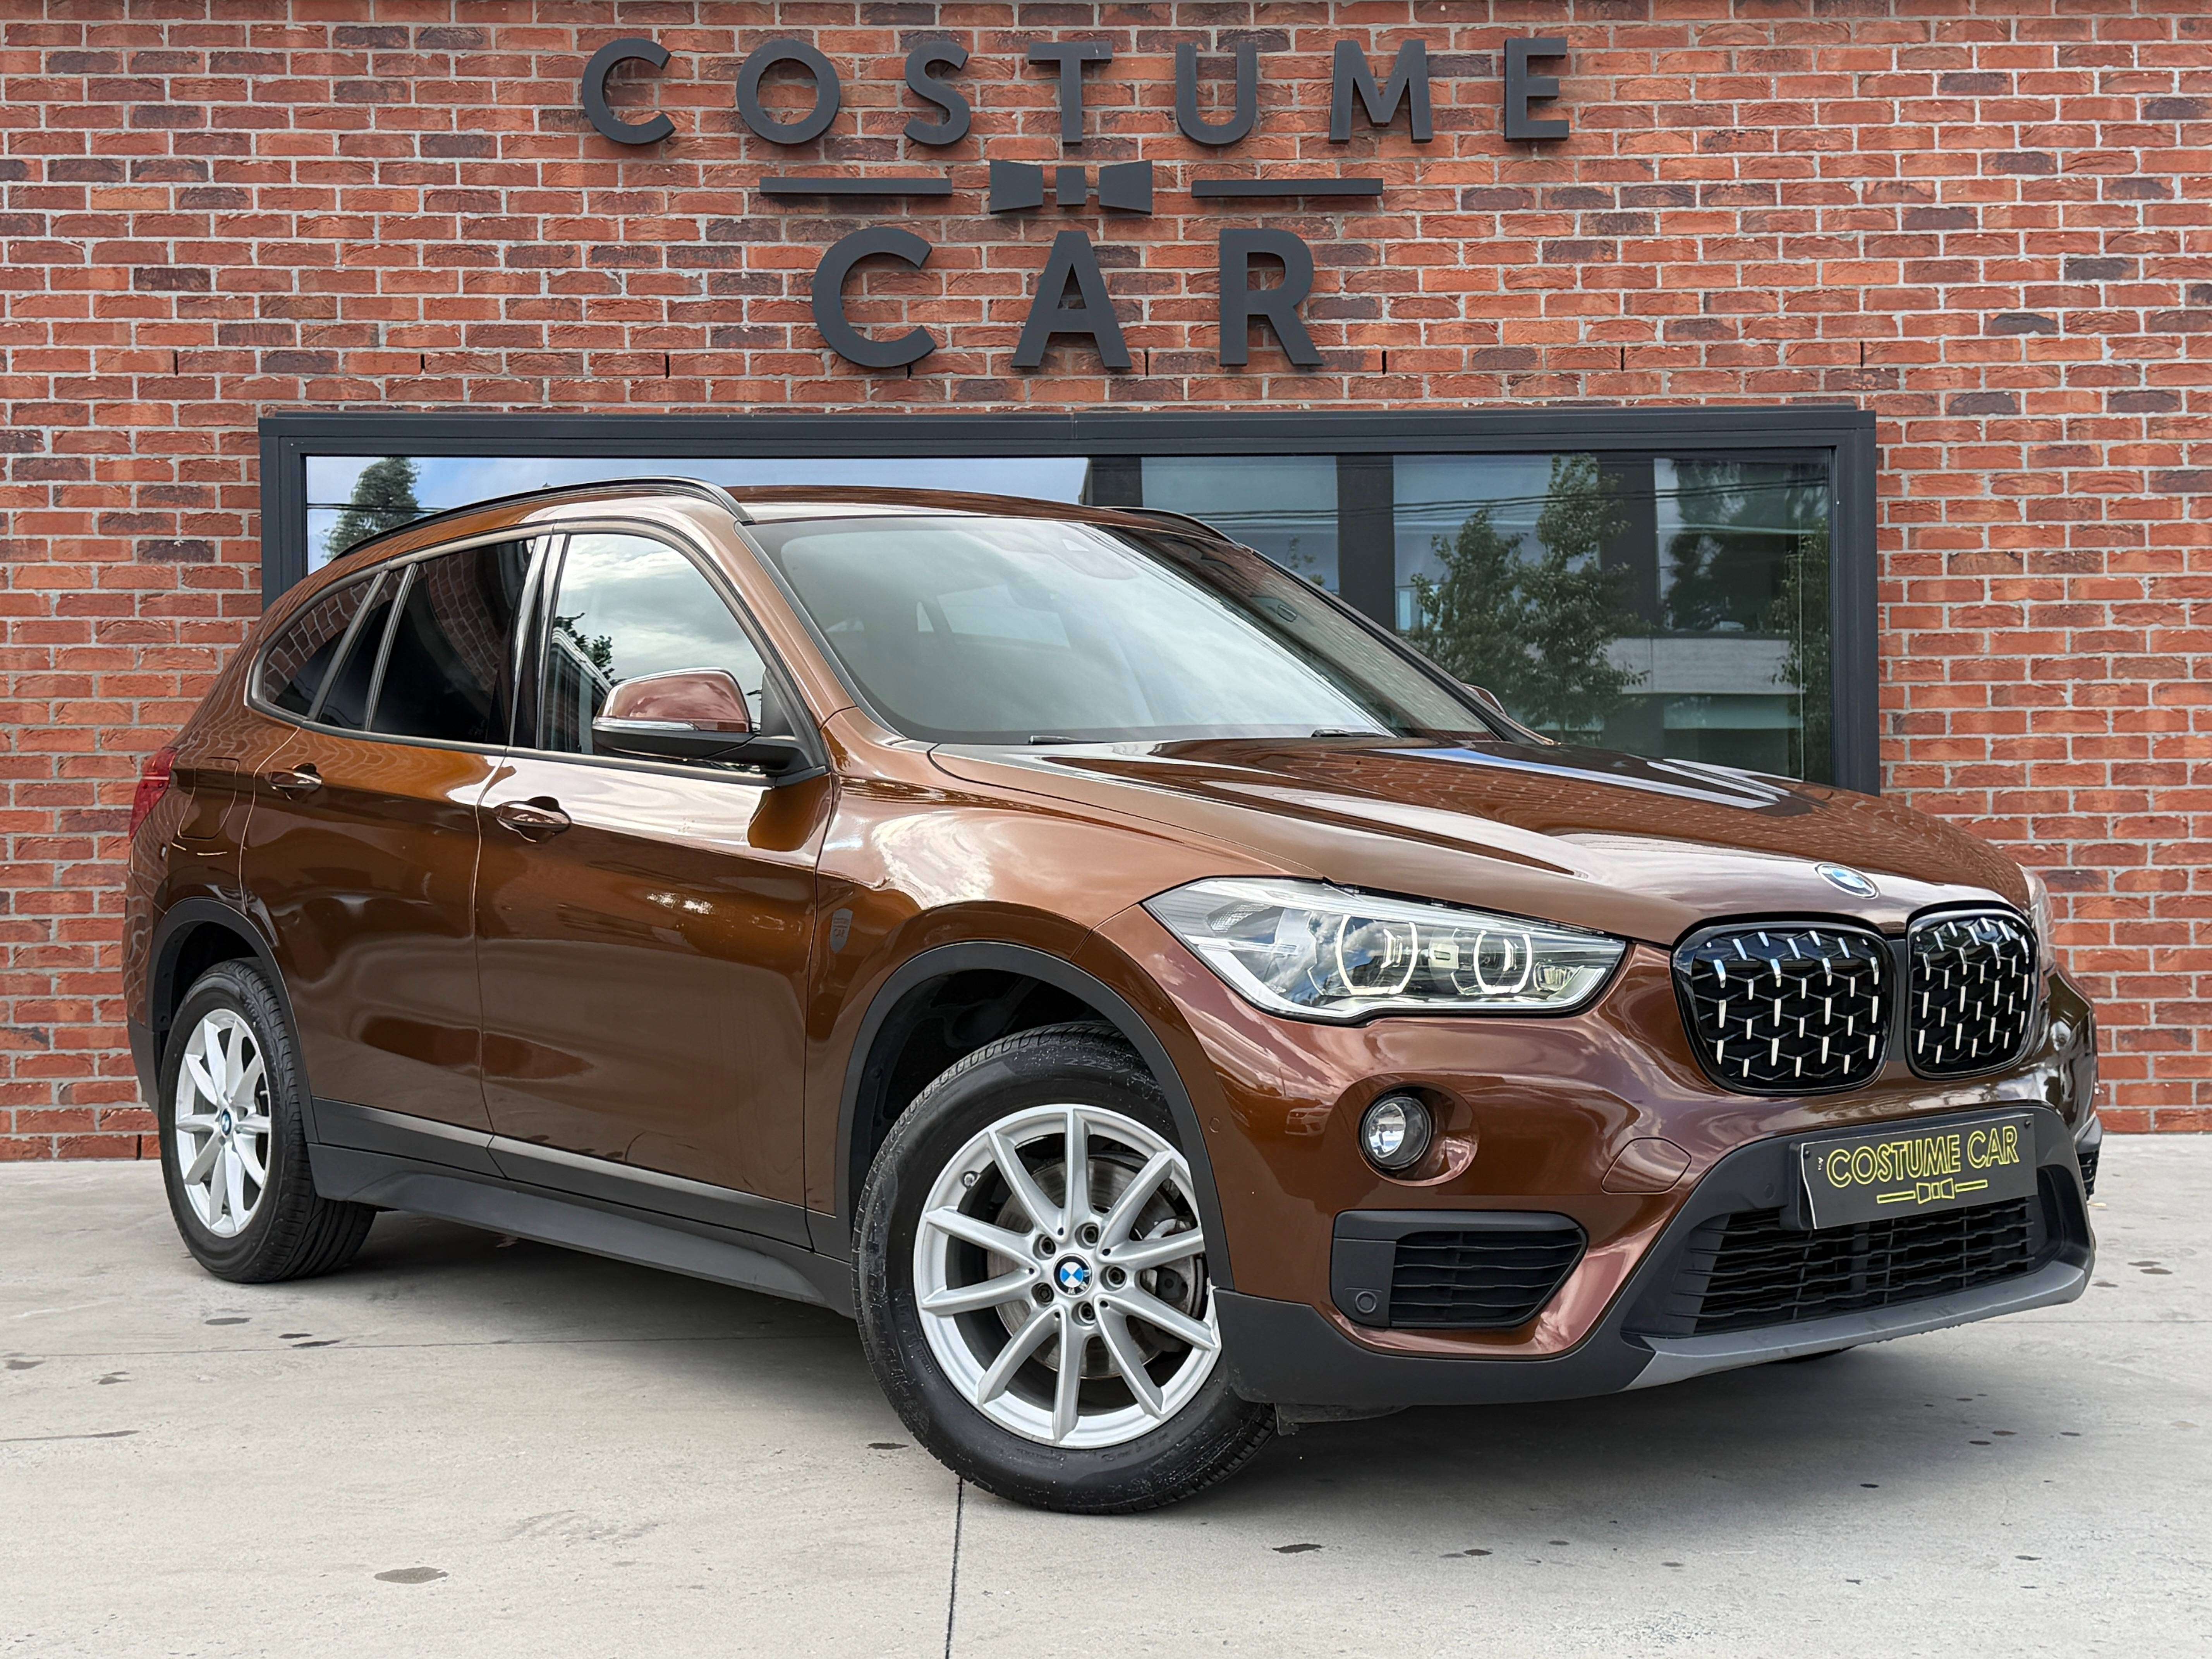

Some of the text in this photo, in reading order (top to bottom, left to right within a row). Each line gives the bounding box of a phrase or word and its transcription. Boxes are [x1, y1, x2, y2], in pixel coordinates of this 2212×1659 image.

[582, 37, 1570, 146] COSTUME
[811, 227, 1324, 368] CAR
[1826, 1125, 2020, 1188] COSTUME CAR
